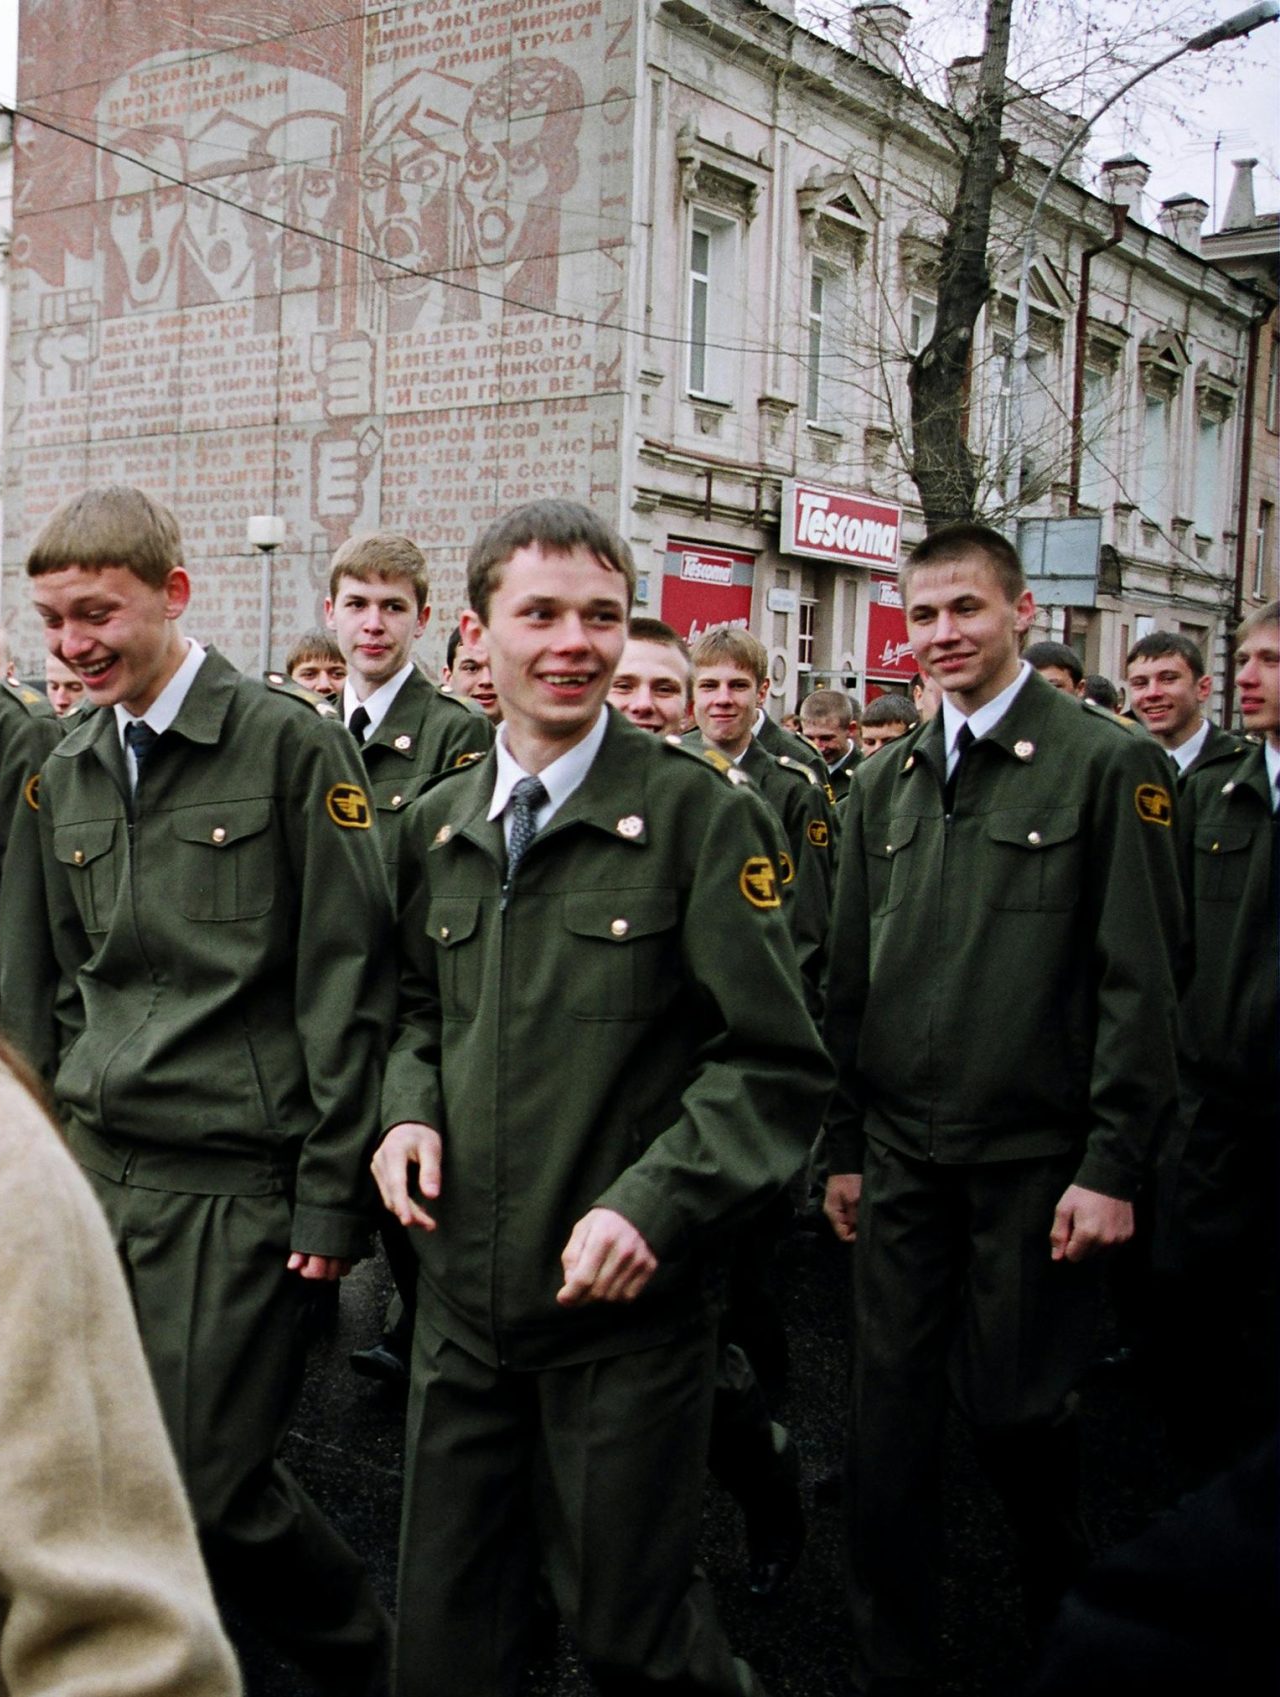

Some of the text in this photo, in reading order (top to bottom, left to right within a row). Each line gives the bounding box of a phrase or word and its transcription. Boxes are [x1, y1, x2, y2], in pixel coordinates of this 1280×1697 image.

[434, 22, 592, 71] АРМИИ ТРУДА
[386, 327, 479, 351] ВЛАДЕТЬ
[385, 347, 467, 371] ИМЕЕМ
[475, 338, 544, 360] ПРАВО
[418, 386, 469, 406] ЕСЛИ
[477, 379, 539, 400] ГРОМ
[542, 395, 590, 415] НАД
[391, 425, 476, 448] СВОРОЙ
[483, 421, 541, 441] ПСОВ
[798, 492, 898, 558] Tescoma
[684, 556, 732, 582] Tescoma
